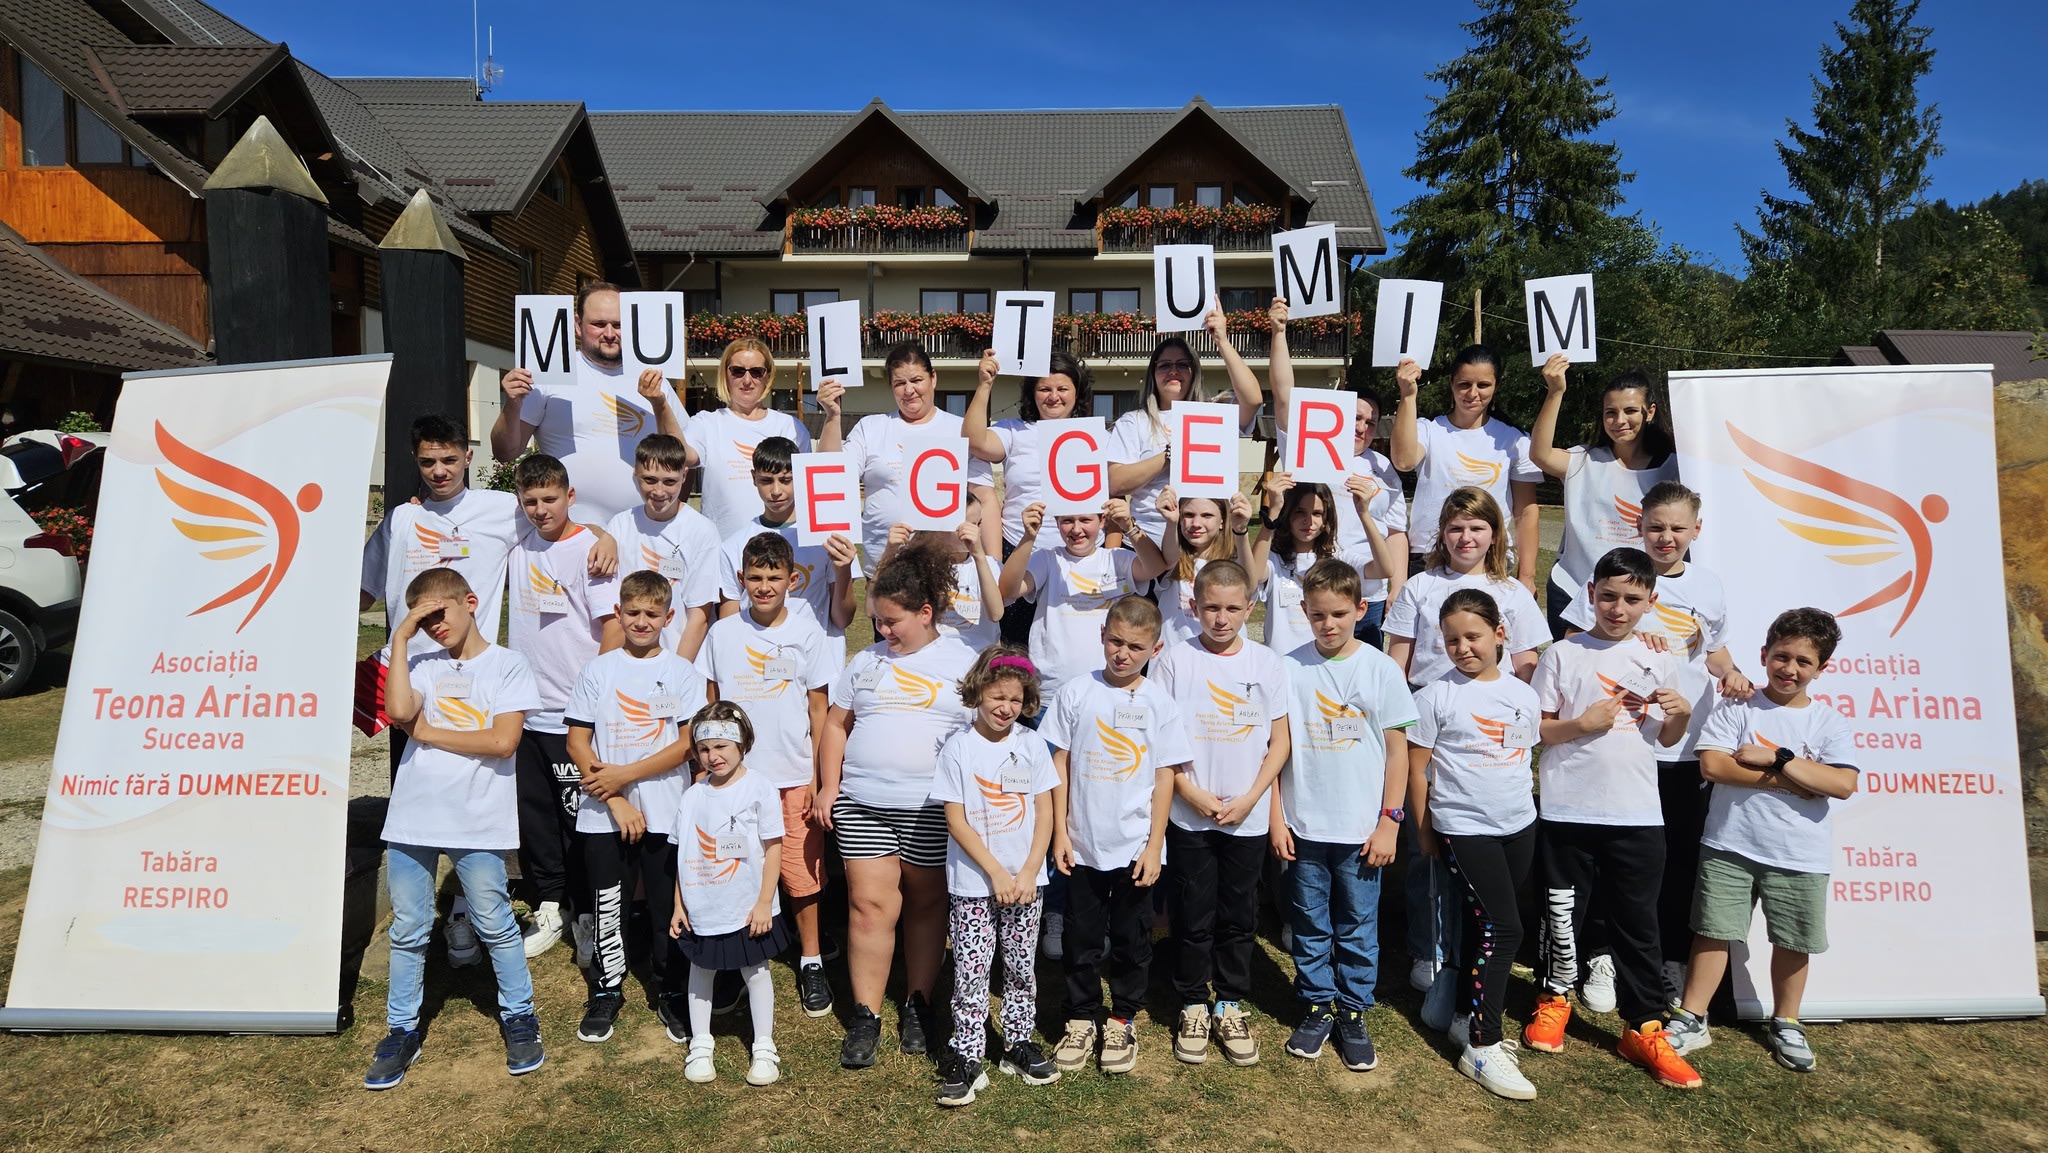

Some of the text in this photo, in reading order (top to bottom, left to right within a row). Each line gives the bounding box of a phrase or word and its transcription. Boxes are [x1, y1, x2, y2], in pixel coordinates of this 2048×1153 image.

[521, 308, 571, 373] M
[632, 303, 673, 365] U
[819, 316, 849, 377] L
[1166, 256, 1206, 319] U
[1280, 237, 1334, 307] M
[1400, 292, 1415, 354] I
[1533, 286, 1589, 354] M
[805, 401, 1345, 533] E G G E R
[152, 651, 258, 678] Asociația
[1825, 653, 1921, 681] sociația
[93, 685, 318, 720] Teona Ariana
[655, 702, 676, 711] DAVID
[1868, 687, 1982, 720] Ariana
[143, 727, 245, 750] Suceava
[1336, 723, 1359, 732] PETRU
[1853, 731, 1922, 749] ceava
[60, 773, 328, 797] Nimic fără DUMNEZEU.
[1866, 772, 2004, 795] DUMNEZEU.
[141, 850, 218, 873] Tabăra
[1842, 846, 1918, 868] Tabăra
[123, 886, 229, 909] RESPIRO
[1833, 881, 1931, 902] RESPIRO
